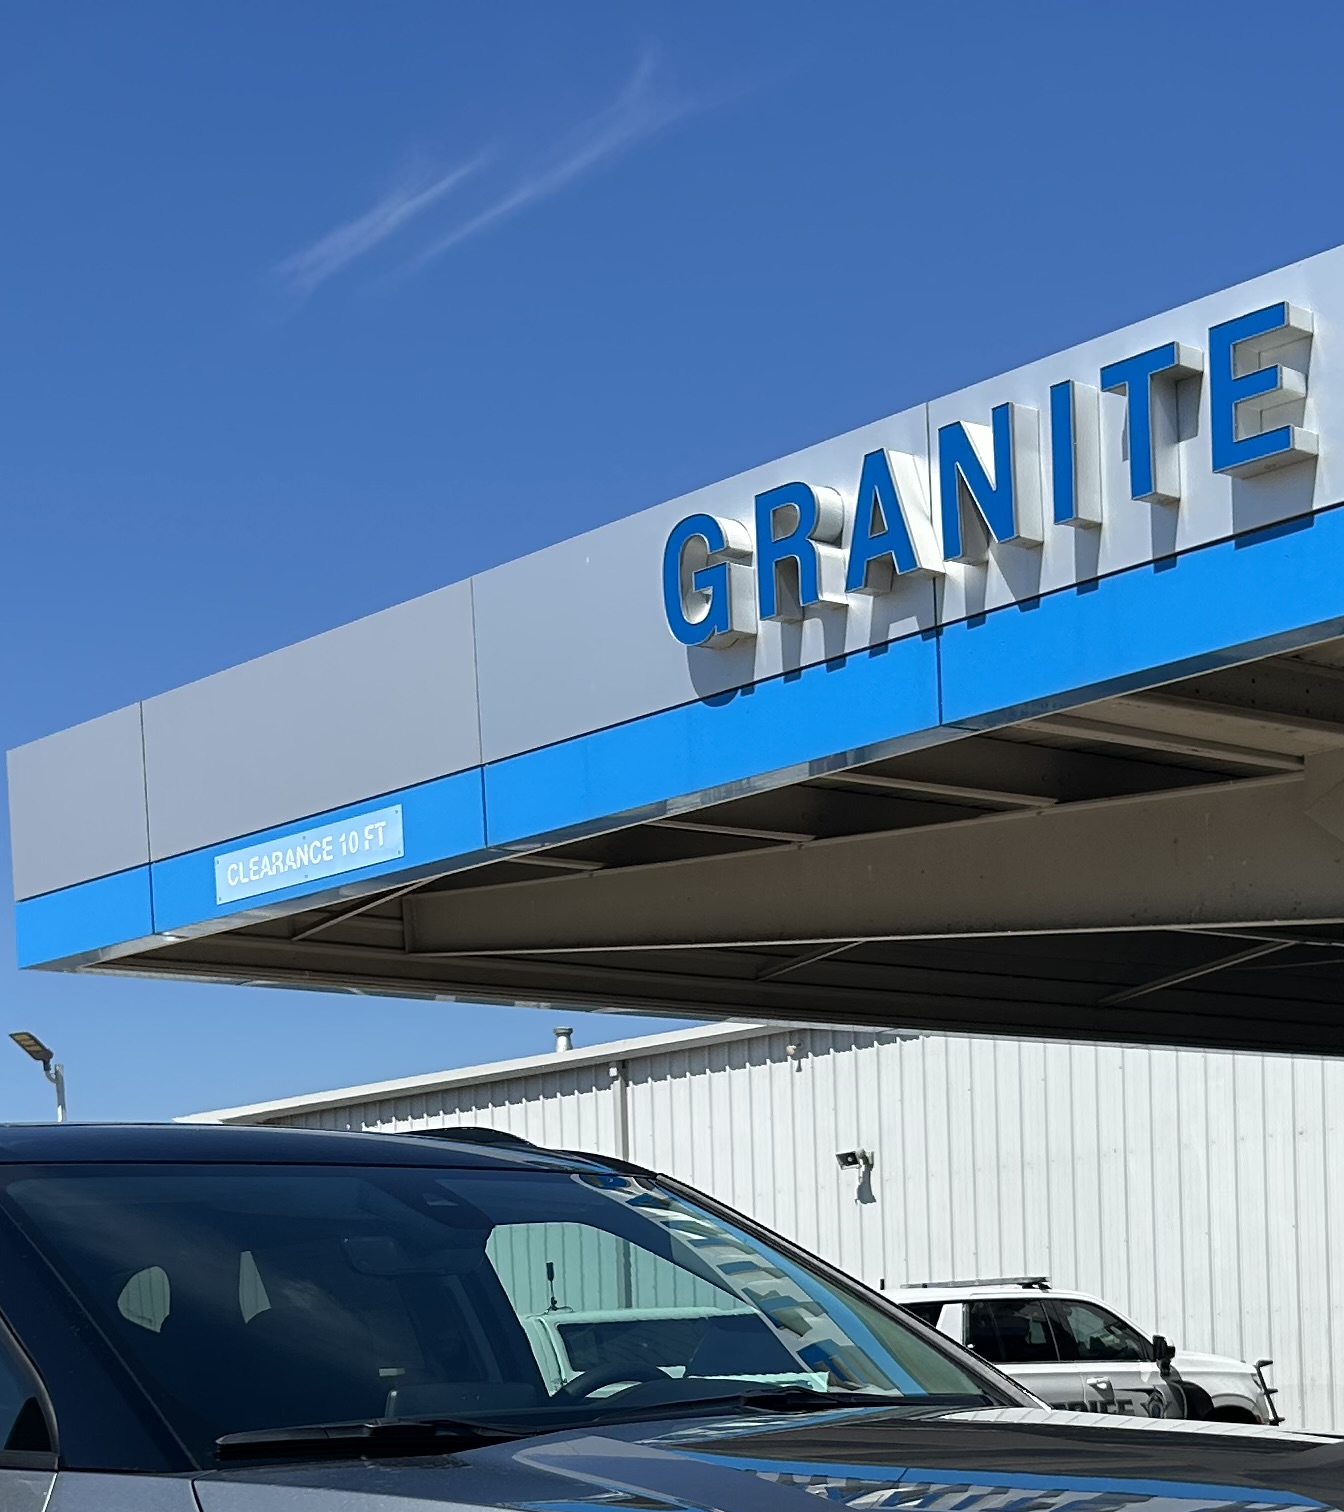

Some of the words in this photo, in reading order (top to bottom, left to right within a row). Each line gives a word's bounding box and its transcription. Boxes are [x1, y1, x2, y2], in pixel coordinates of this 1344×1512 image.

[663, 301, 1316, 649] GRANITE
[226, 835, 333, 886] CLEARANCE
[340, 831, 359, 857] 10
[364, 821, 387, 851] FT
